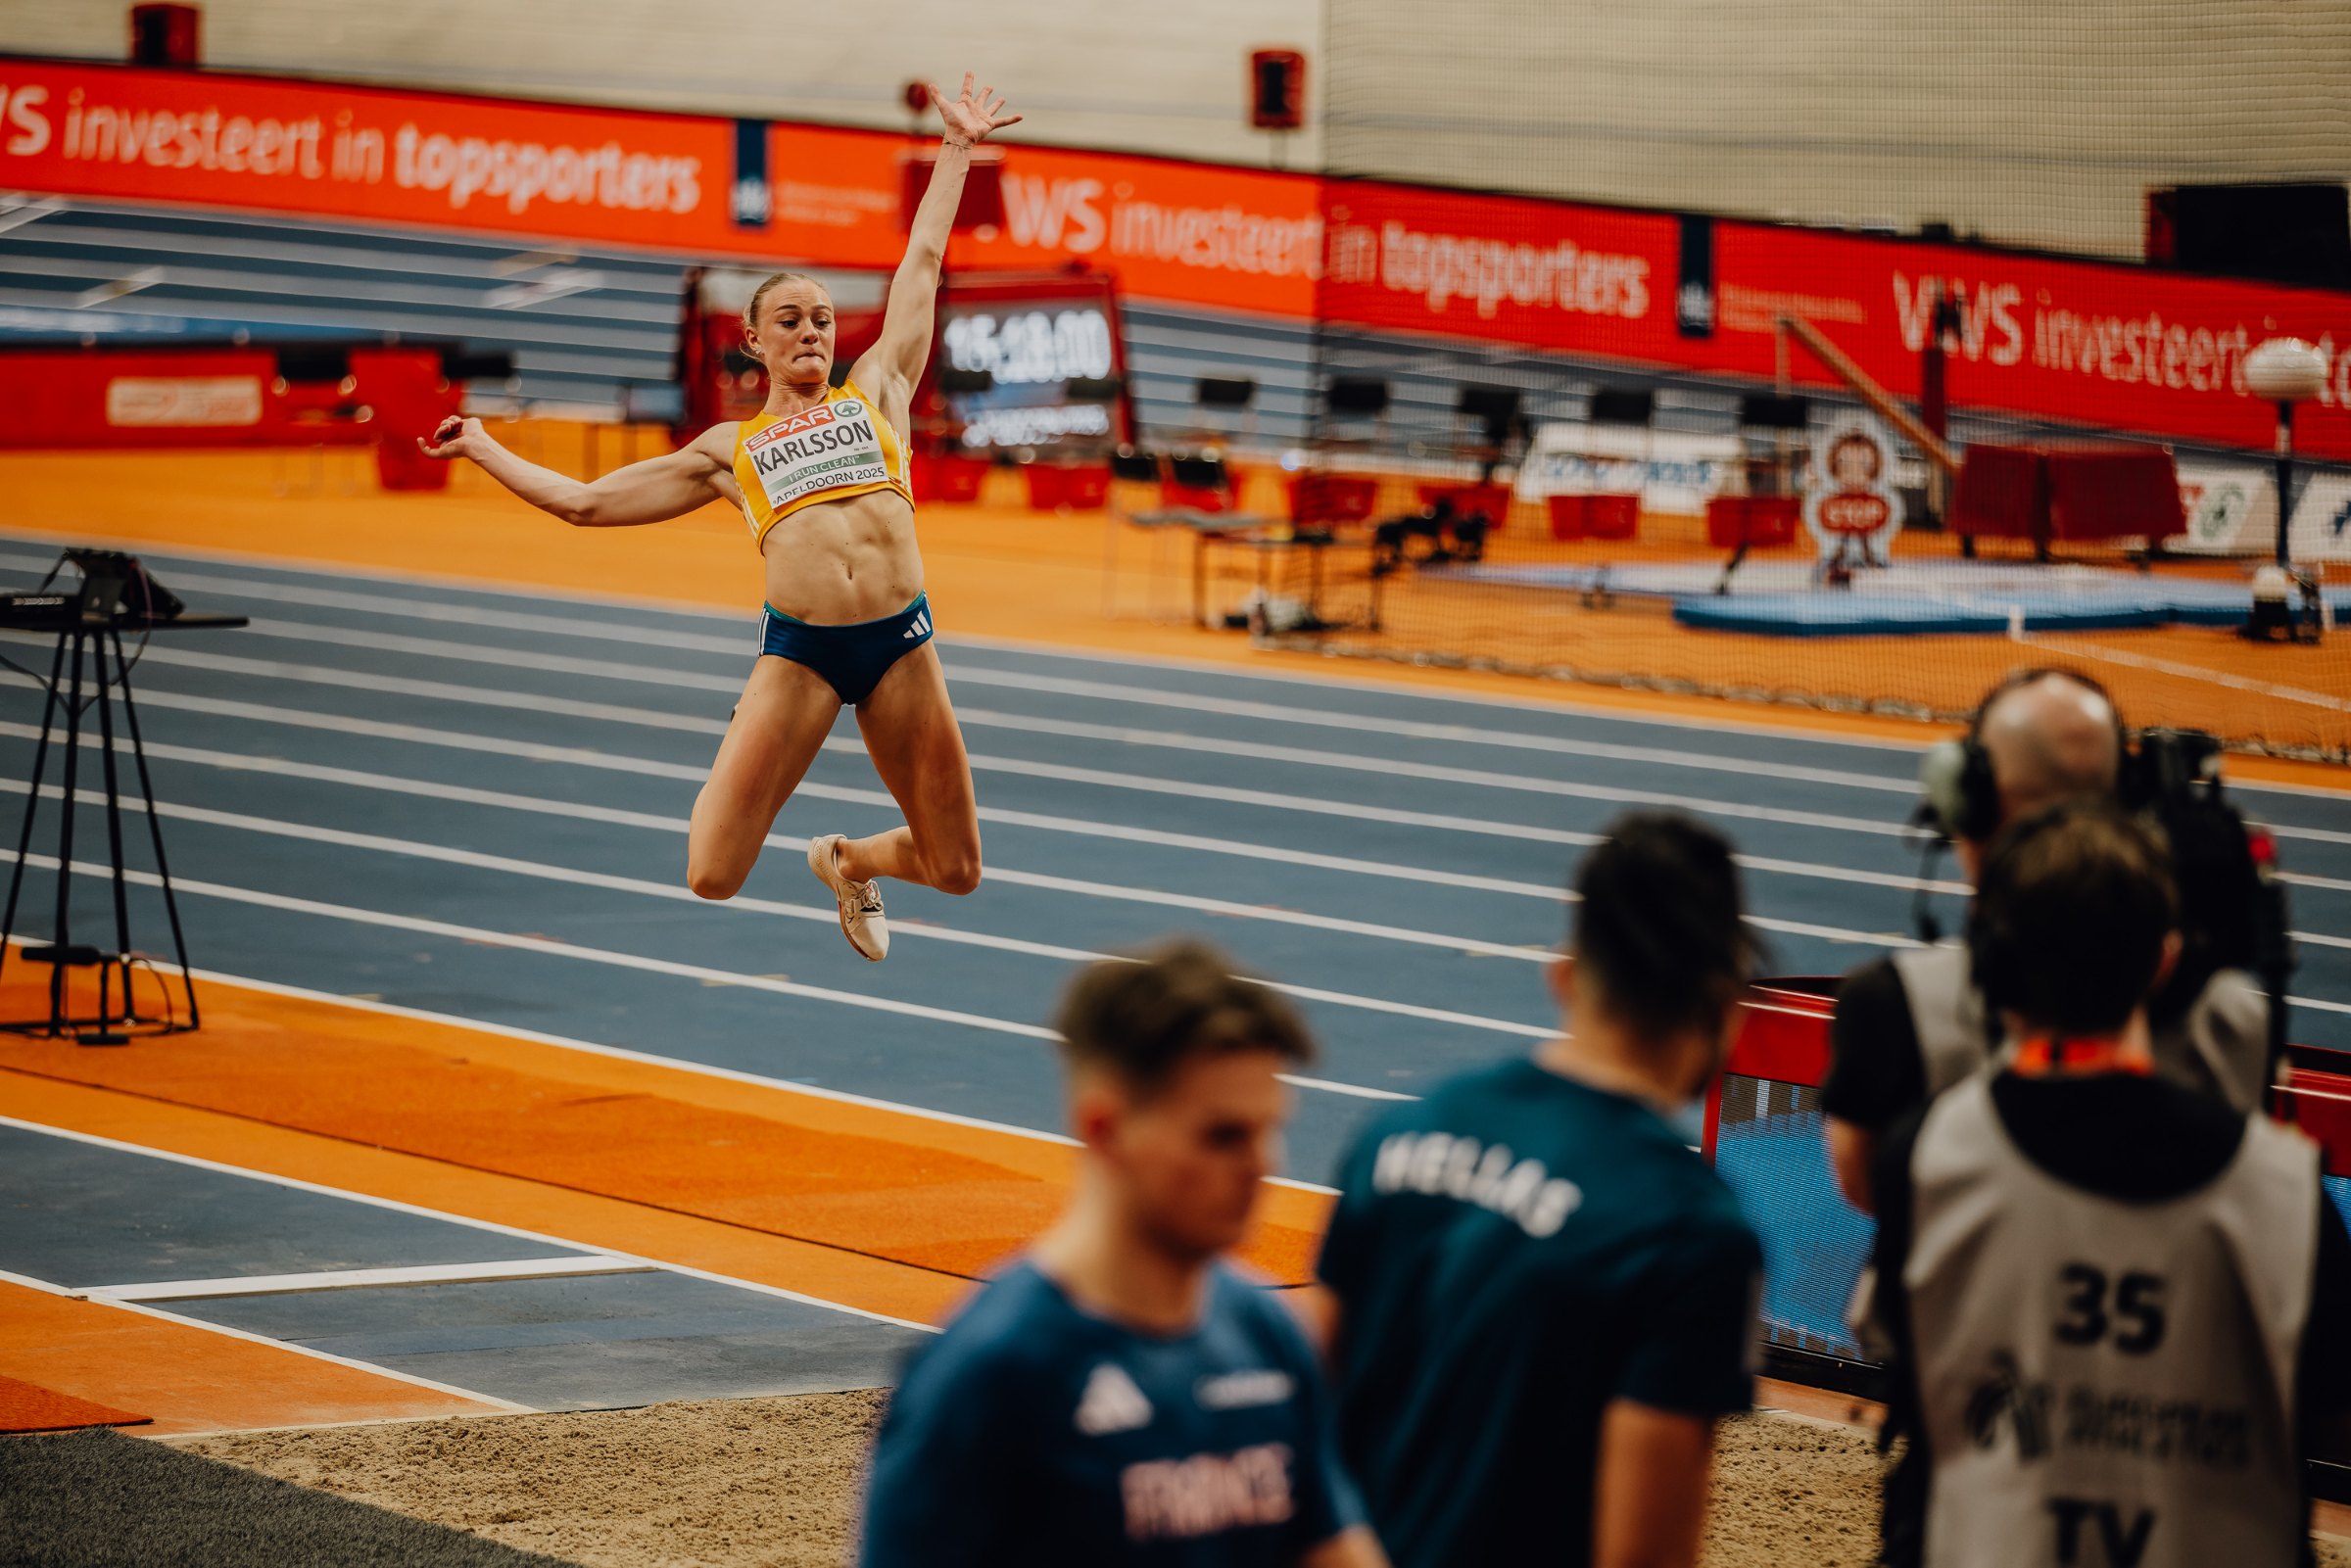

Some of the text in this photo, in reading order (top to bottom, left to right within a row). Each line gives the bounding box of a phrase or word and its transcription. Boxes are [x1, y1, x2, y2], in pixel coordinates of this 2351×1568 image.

[62, 86, 324, 181] investeert
[332, 109, 386, 184] in
[394, 120, 701, 214] topsporters
[1110, 181, 1325, 281] investeert
[1328, 204, 1377, 284] in
[1379, 220, 1651, 319] topsporters
[2032, 288, 2250, 398] investeert
[747, 408, 832, 448] SPAR
[753, 419, 873, 476] KARLSSON
[776, 467, 885, 505] APELDOORN 2025
[793, 465, 819, 482] RUN
[1373, 1130, 1583, 1240] HELLAS
[2055, 1262, 2167, 1355] 35
[2045, 1494, 2157, 1568] TV
